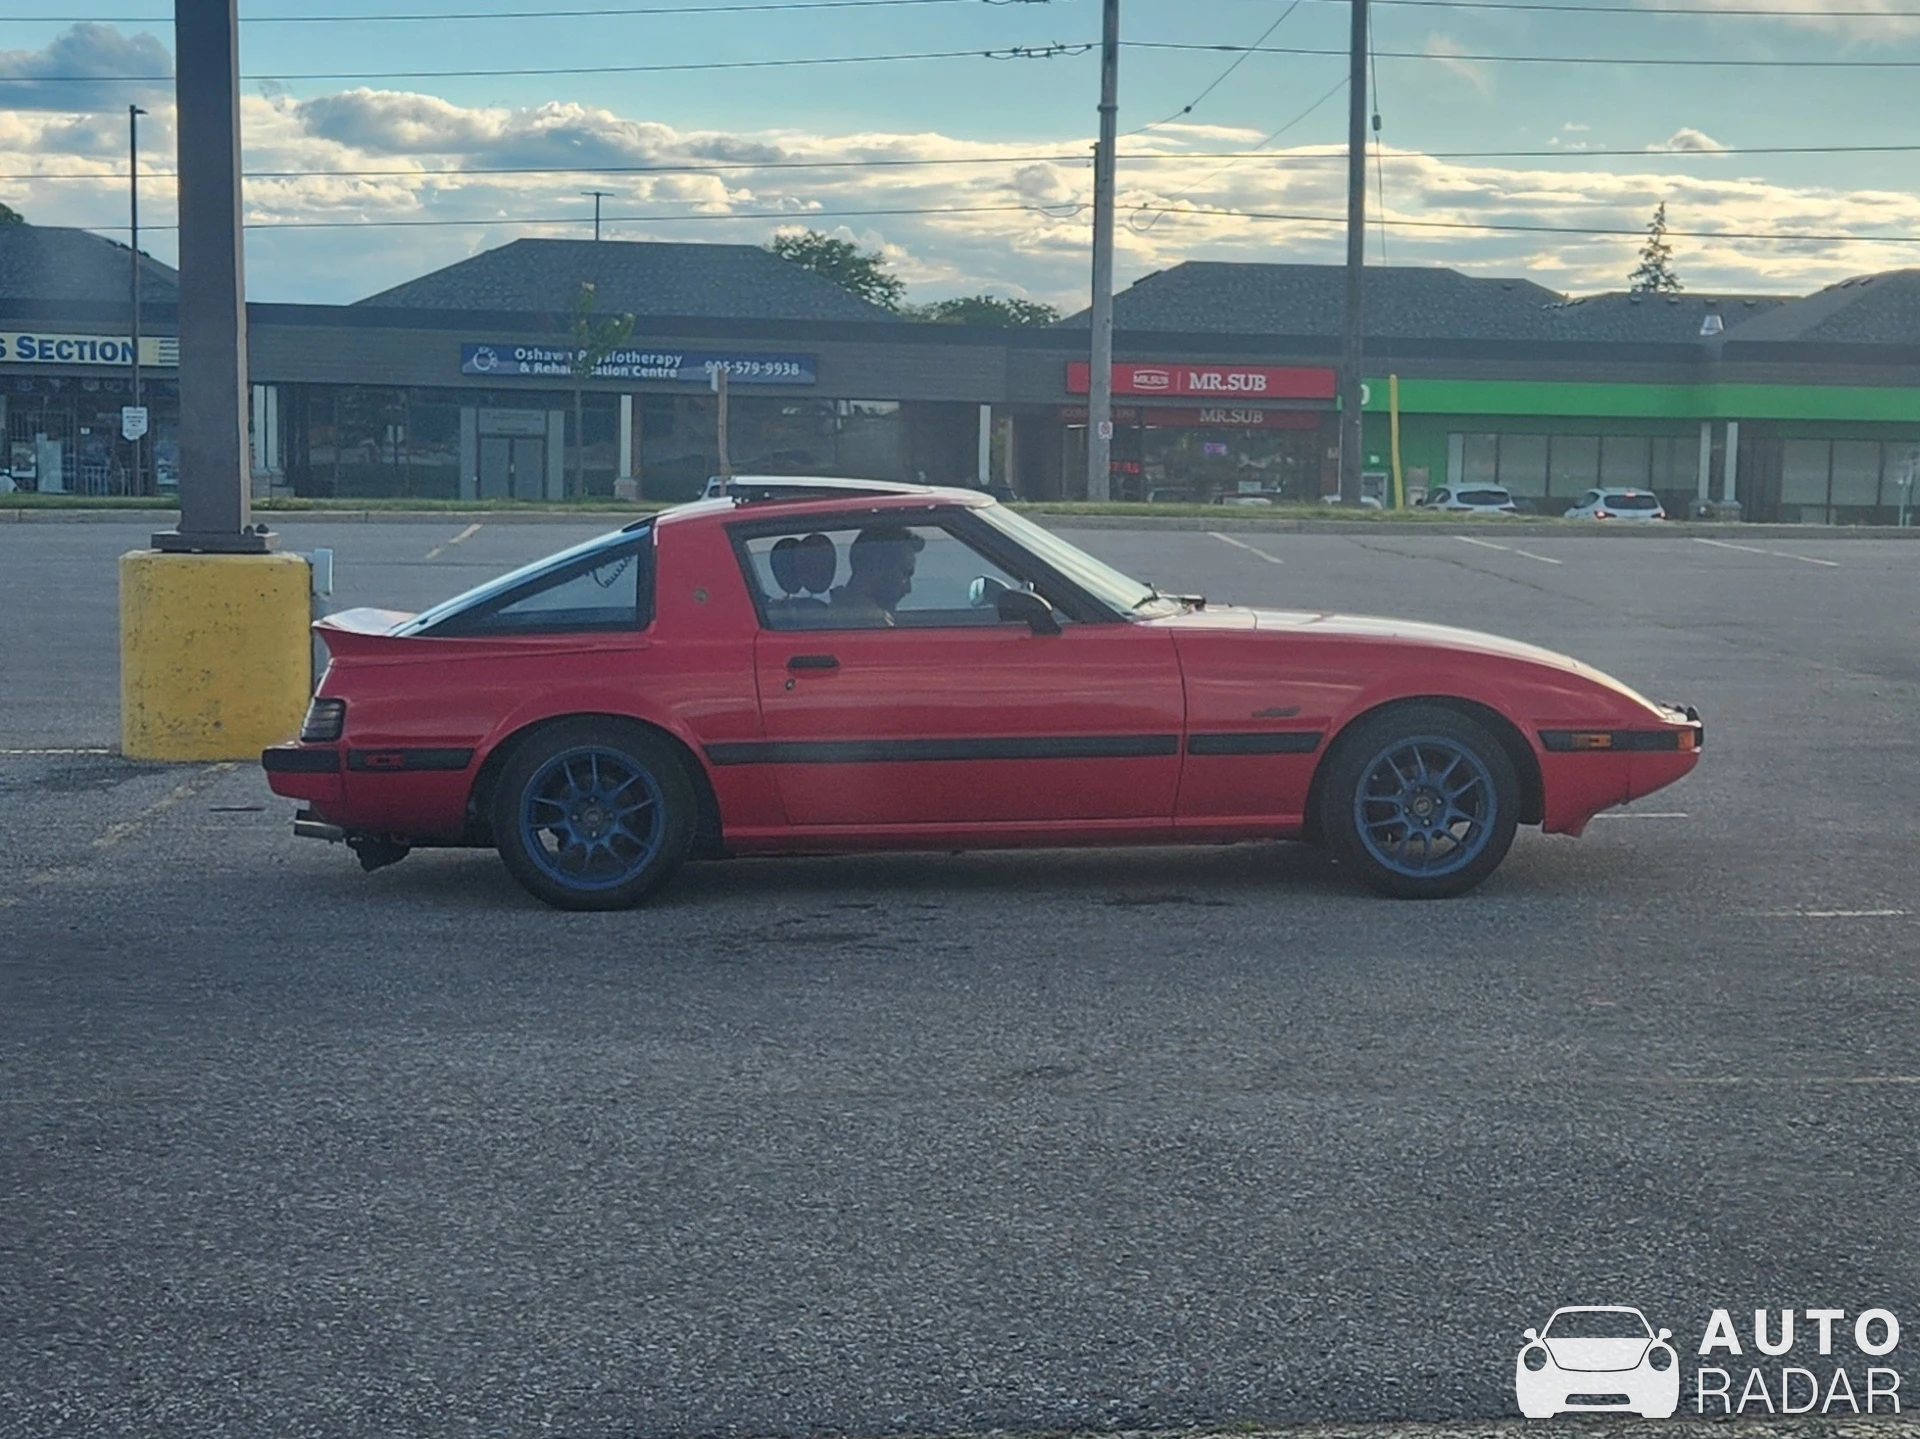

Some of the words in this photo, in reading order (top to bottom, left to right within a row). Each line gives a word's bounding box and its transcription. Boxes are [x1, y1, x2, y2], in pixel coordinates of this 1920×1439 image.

[16, 336, 135, 362] SECTION
[578, 350, 682, 369] Psiotherapy
[704, 360, 800, 376] 905-579-9938
[520, 361, 530, 374] &
[534, 362, 628, 376] Rehaation
[632, 365, 677, 378] Centre
[1133, 374, 1169, 385] MR.SUB
[1189, 372, 1267, 391] MR.SUB
[1200, 409, 1264, 424] MR.SUB
